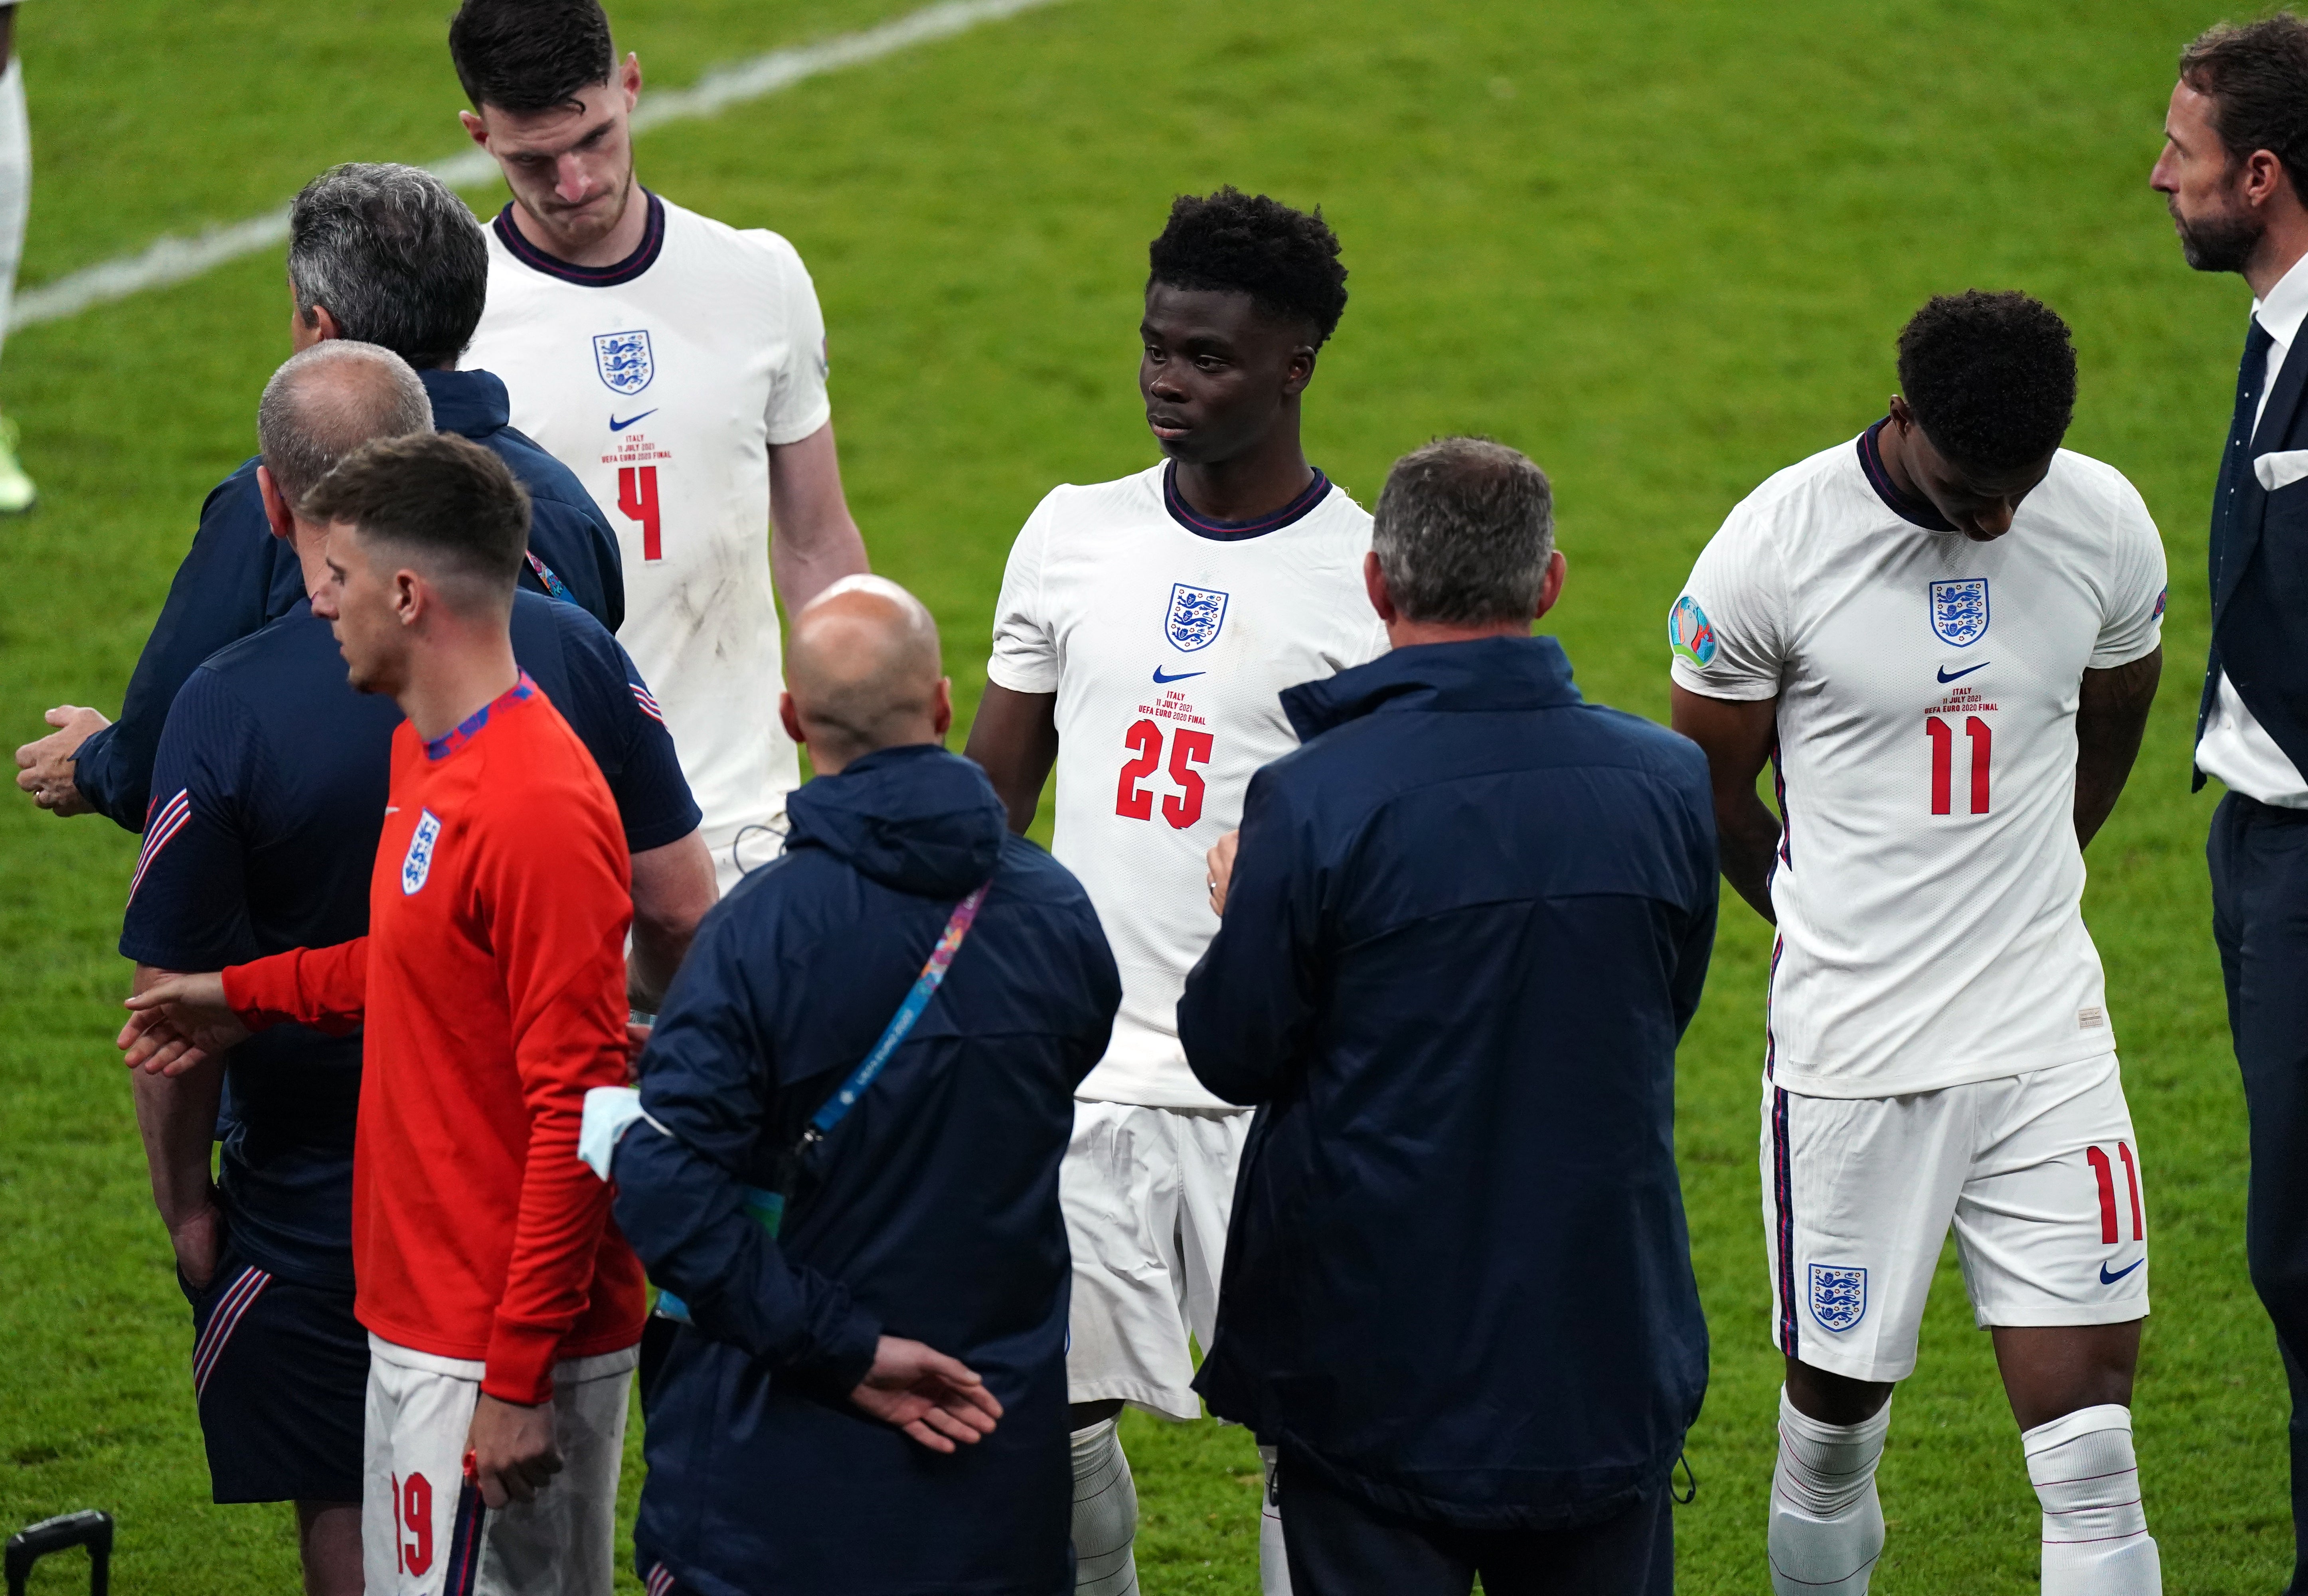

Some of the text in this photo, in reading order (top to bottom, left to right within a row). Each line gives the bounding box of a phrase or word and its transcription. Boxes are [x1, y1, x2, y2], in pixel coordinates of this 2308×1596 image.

[626, 434, 644, 442] ITALY
[601, 455, 617, 463] UEFA
[620, 453, 636, 462] EURO
[618, 466, 661, 561] 4
[1162, 700, 1178, 709] JULY
[1179, 703, 1192, 712] 2021
[1167, 691, 1185, 701] ITALY
[1138, 705, 1205, 725] UEFA EURO 2020 FINAL
[1116, 719, 1213, 830] 25
[1927, 716, 1991, 814] 11
[2087, 1142, 2143, 1244] 11
